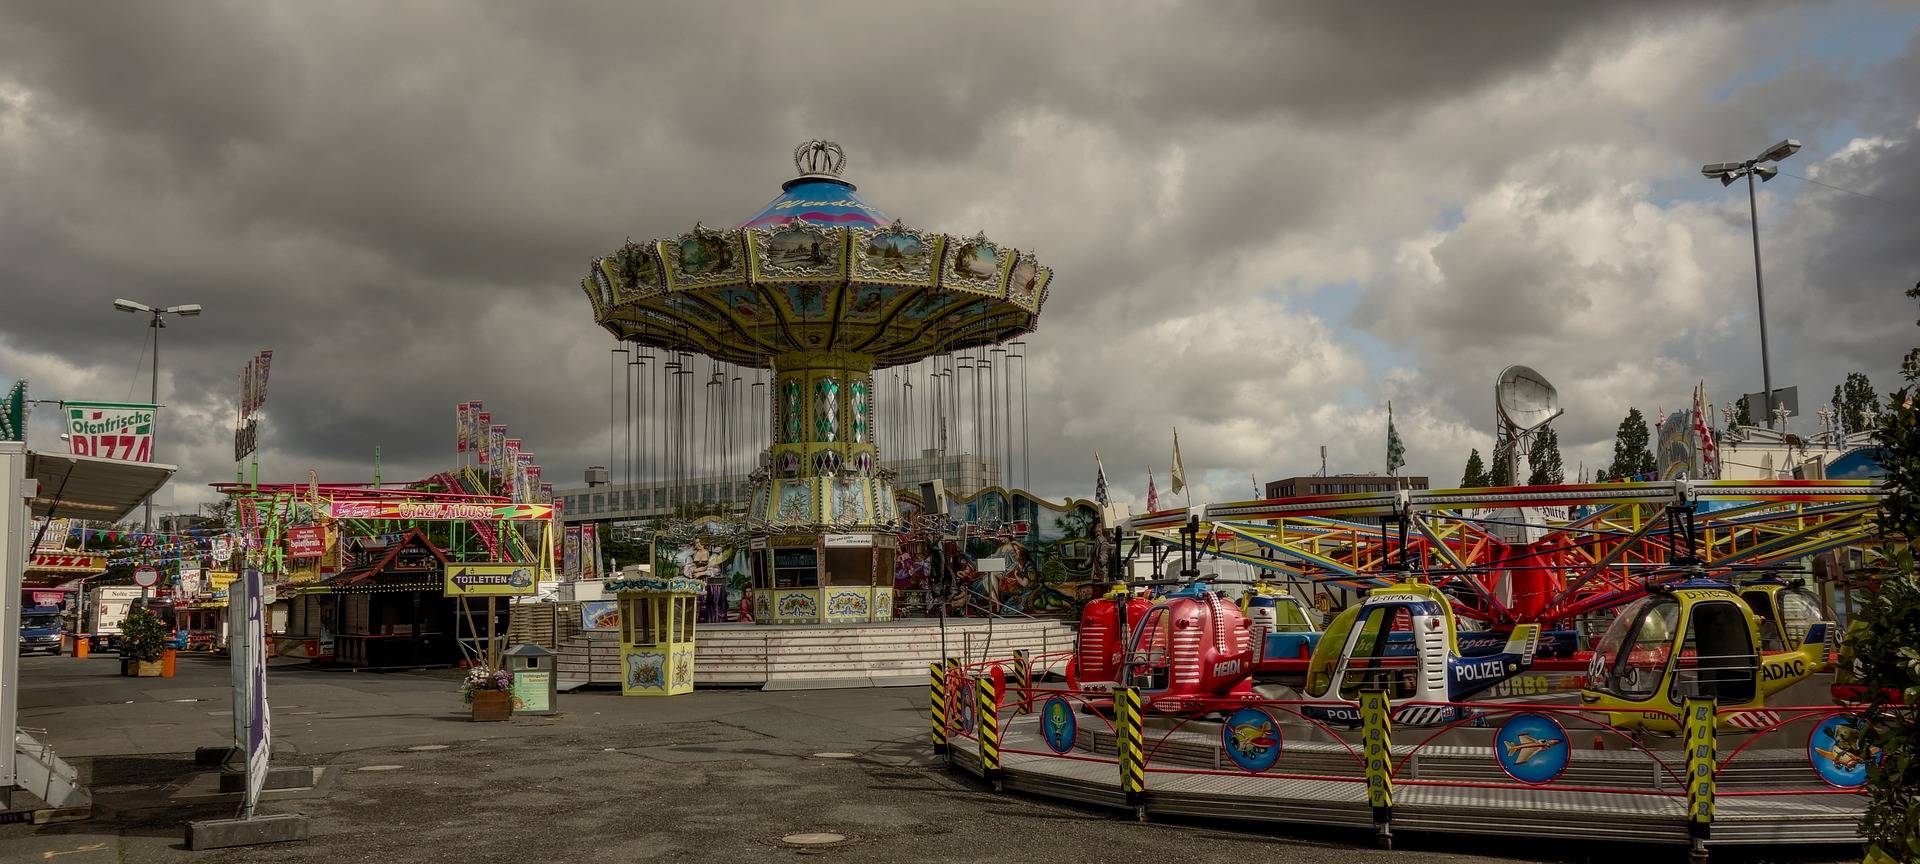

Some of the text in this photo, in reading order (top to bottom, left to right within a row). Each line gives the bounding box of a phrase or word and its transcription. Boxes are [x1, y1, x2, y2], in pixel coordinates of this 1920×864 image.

[72, 411, 152, 434] Ofenfrische
[1687, 488, 1693, 497] 5
[456, 576, 507, 584] TOILETTEN
[1213, 658, 1241, 677] HEIDI
[1455, 660, 1505, 681] POLIZEI
[1762, 659, 1805, 681] ADAC
[1327, 709, 1361, 721] POLI
[1368, 697, 1383, 802] AIRPORT
[1695, 706, 1710, 817] KINDER
